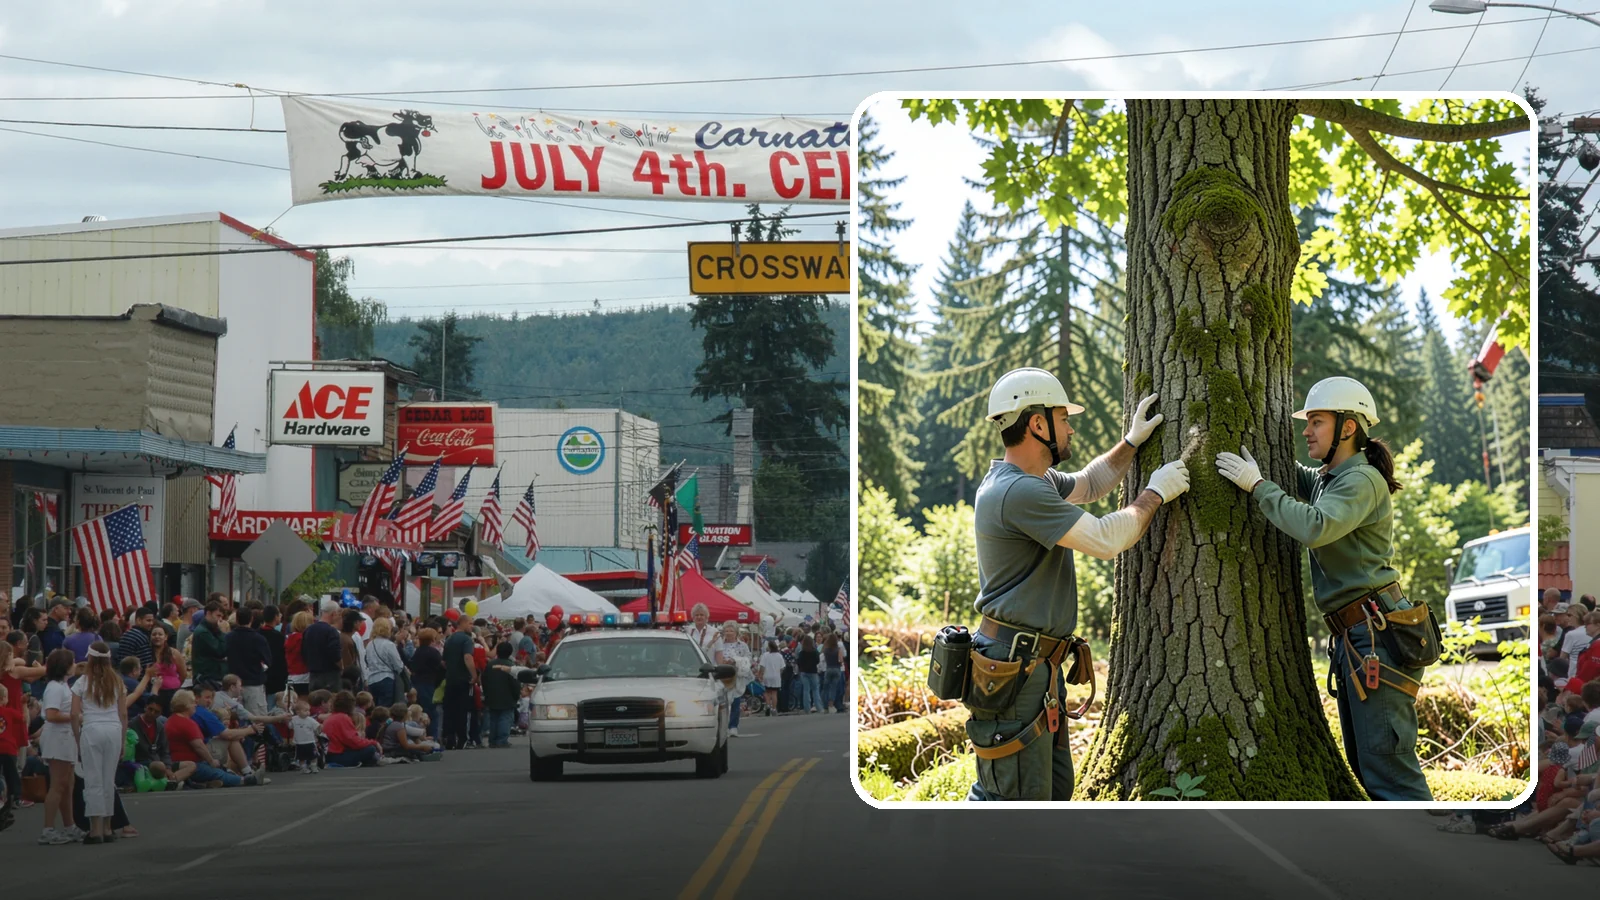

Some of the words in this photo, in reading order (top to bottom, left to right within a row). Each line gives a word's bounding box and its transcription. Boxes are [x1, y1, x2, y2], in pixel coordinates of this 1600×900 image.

[481, 141, 605, 192] JULY
[632, 150, 746, 198] 4th.
[697, 254, 850, 280] CROSSWA
[283, 380, 373, 420] ACE
[405, 410, 452, 422] CEDAR
[283, 421, 370, 436] Hardware
[416, 428, 477, 447] Coca-Cola
[353, 467, 386, 480] Simpl
[96, 485, 124, 495] Vincent
[126, 486, 136, 495] de
[138, 486, 155, 495] Paul
[81, 503, 154, 522] THT
[213, 516, 331, 535] HARDARE
[688, 526, 741, 535] CRNATION
[699, 535, 730, 543] GLASS
